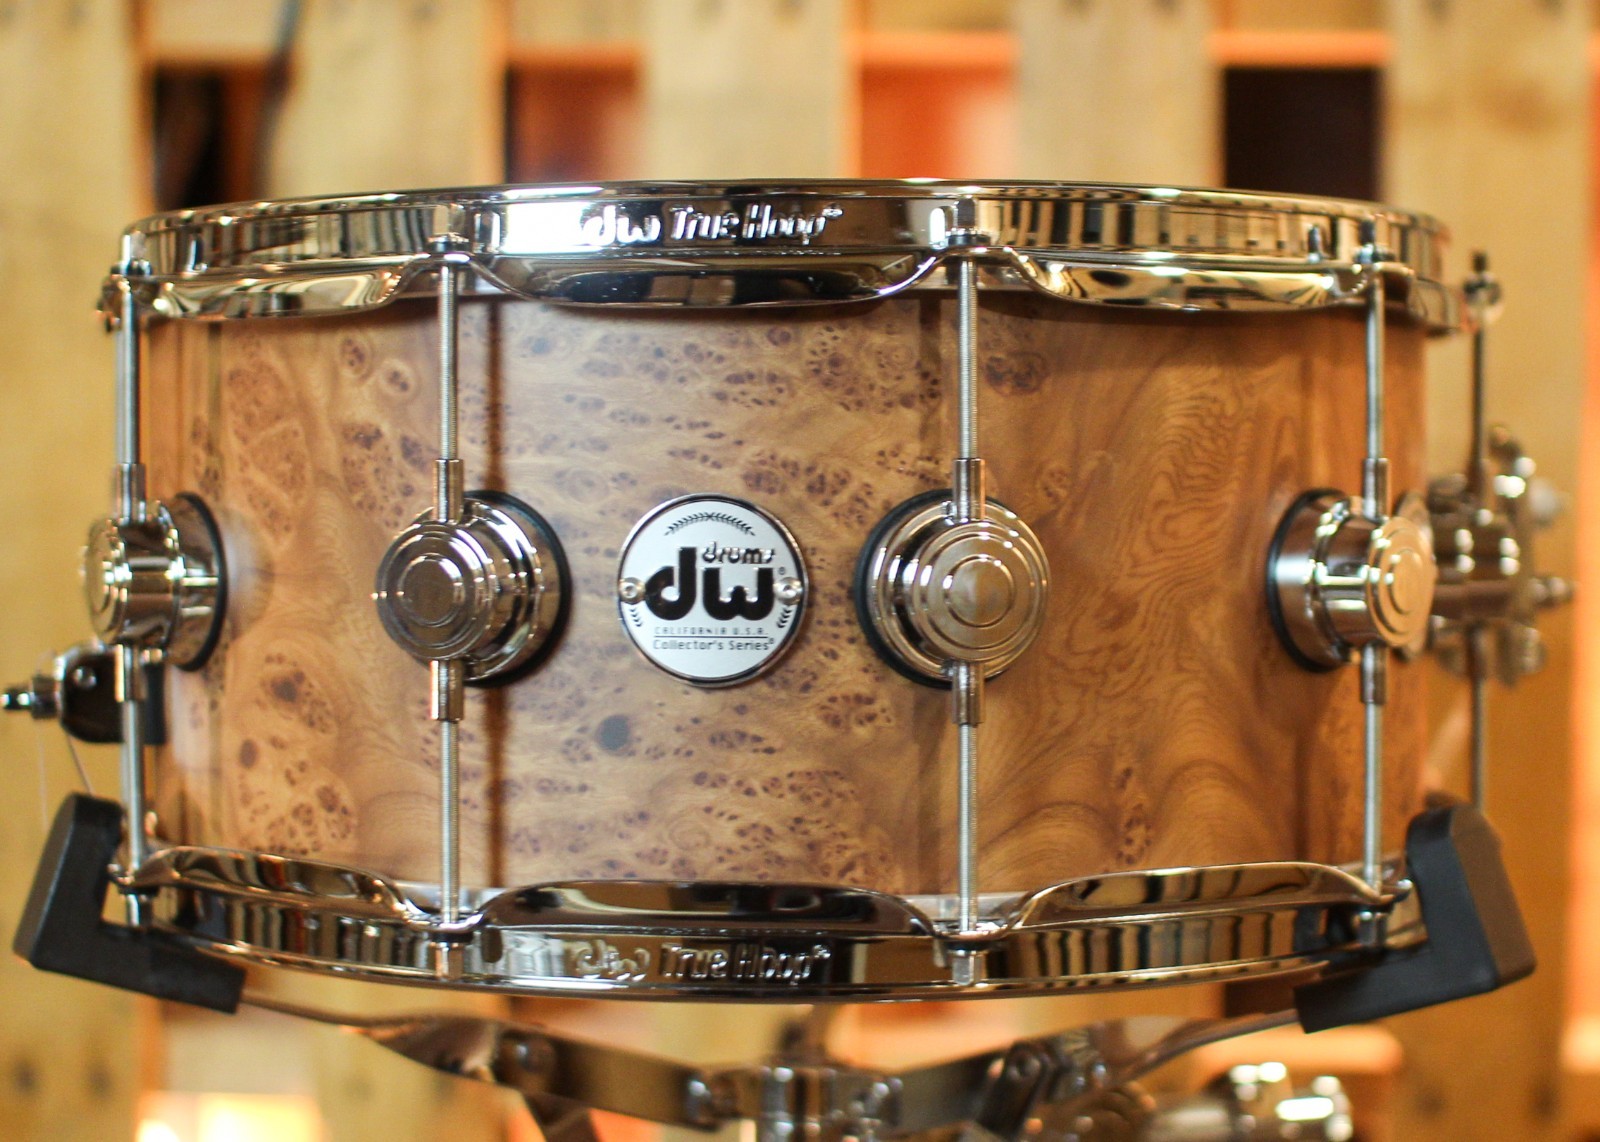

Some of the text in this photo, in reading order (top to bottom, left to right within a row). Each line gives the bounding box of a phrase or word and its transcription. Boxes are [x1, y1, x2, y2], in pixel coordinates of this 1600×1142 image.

[670, 205, 740, 240] True
[742, 203, 827, 245] Hoop
[702, 541, 775, 564] drums
[644, 547, 775, 620] dw
[653, 639, 724, 650] Collector's
[654, 626, 726, 635] CALIFORNIA
[661, 942, 729, 979] True
[733, 943, 813, 986] Hoop
